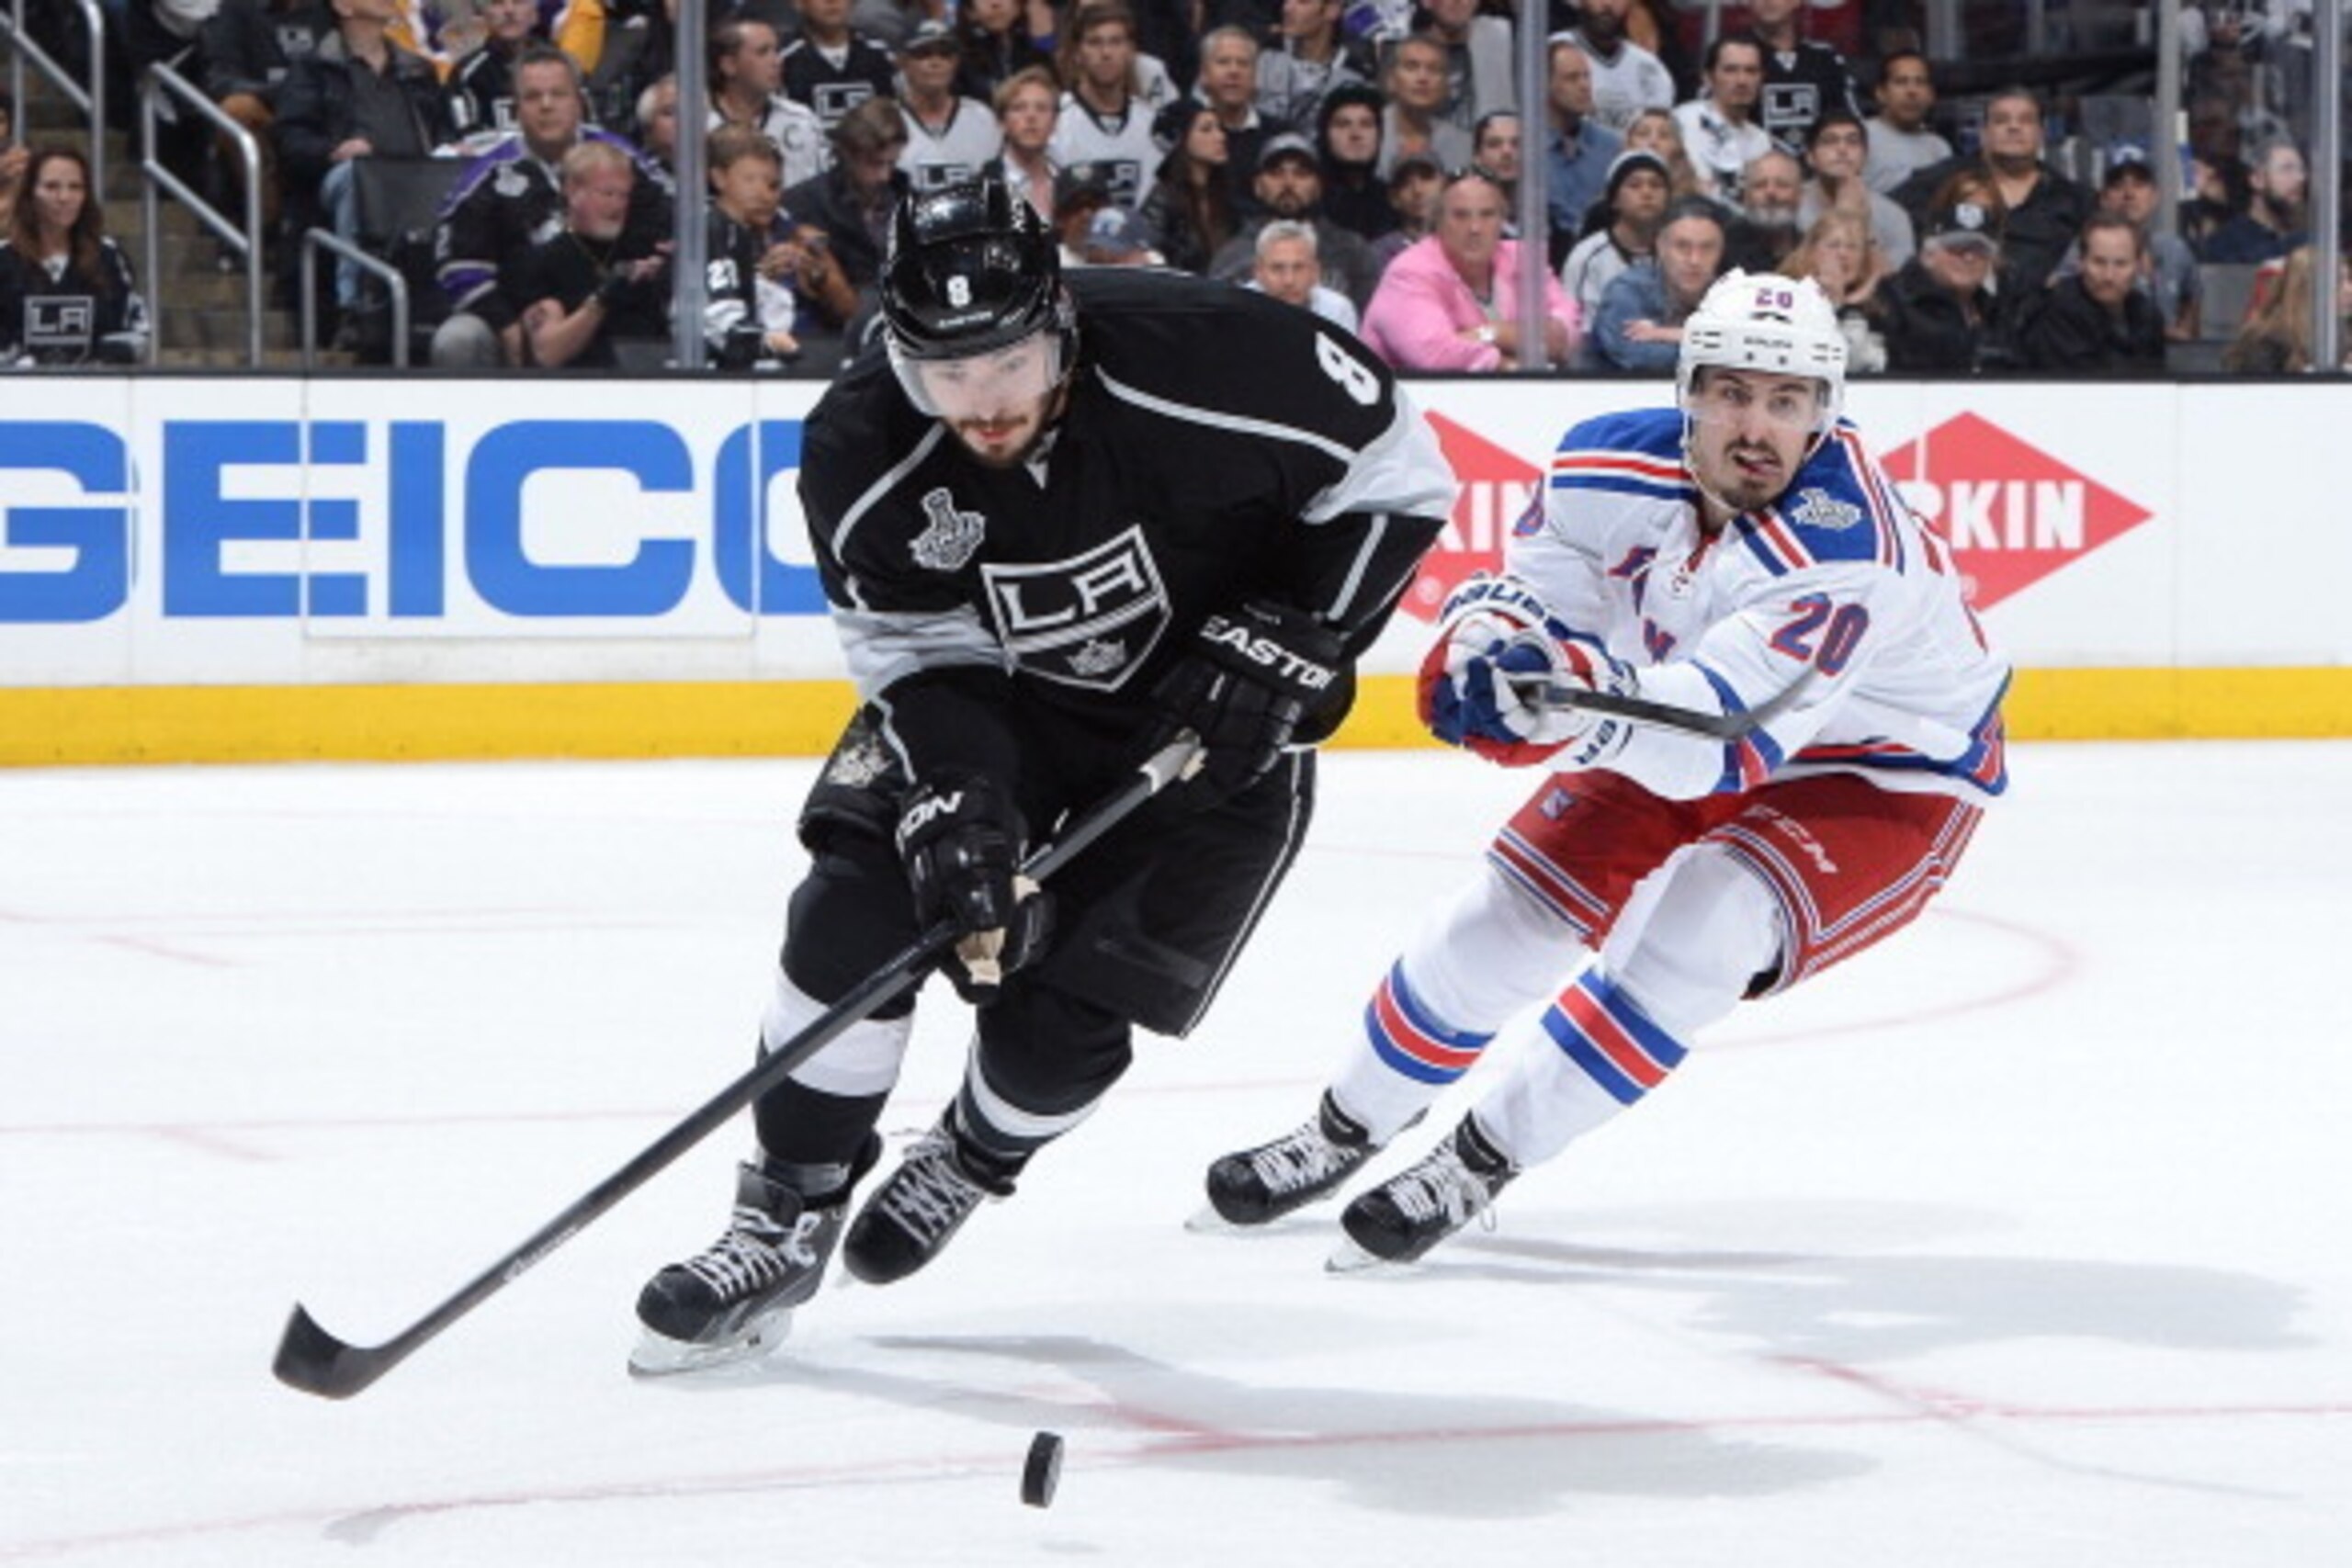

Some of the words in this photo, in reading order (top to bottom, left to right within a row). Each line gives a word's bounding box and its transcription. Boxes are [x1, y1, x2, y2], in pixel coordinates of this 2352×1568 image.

[947, 275, 972, 308] 8
[1756, 288, 1793, 310] 20
[31, 306, 87, 333] LA
[1315, 331, 1381, 405] 8
[995, 548, 1146, 631] LA
[1769, 591, 1870, 678] 20
